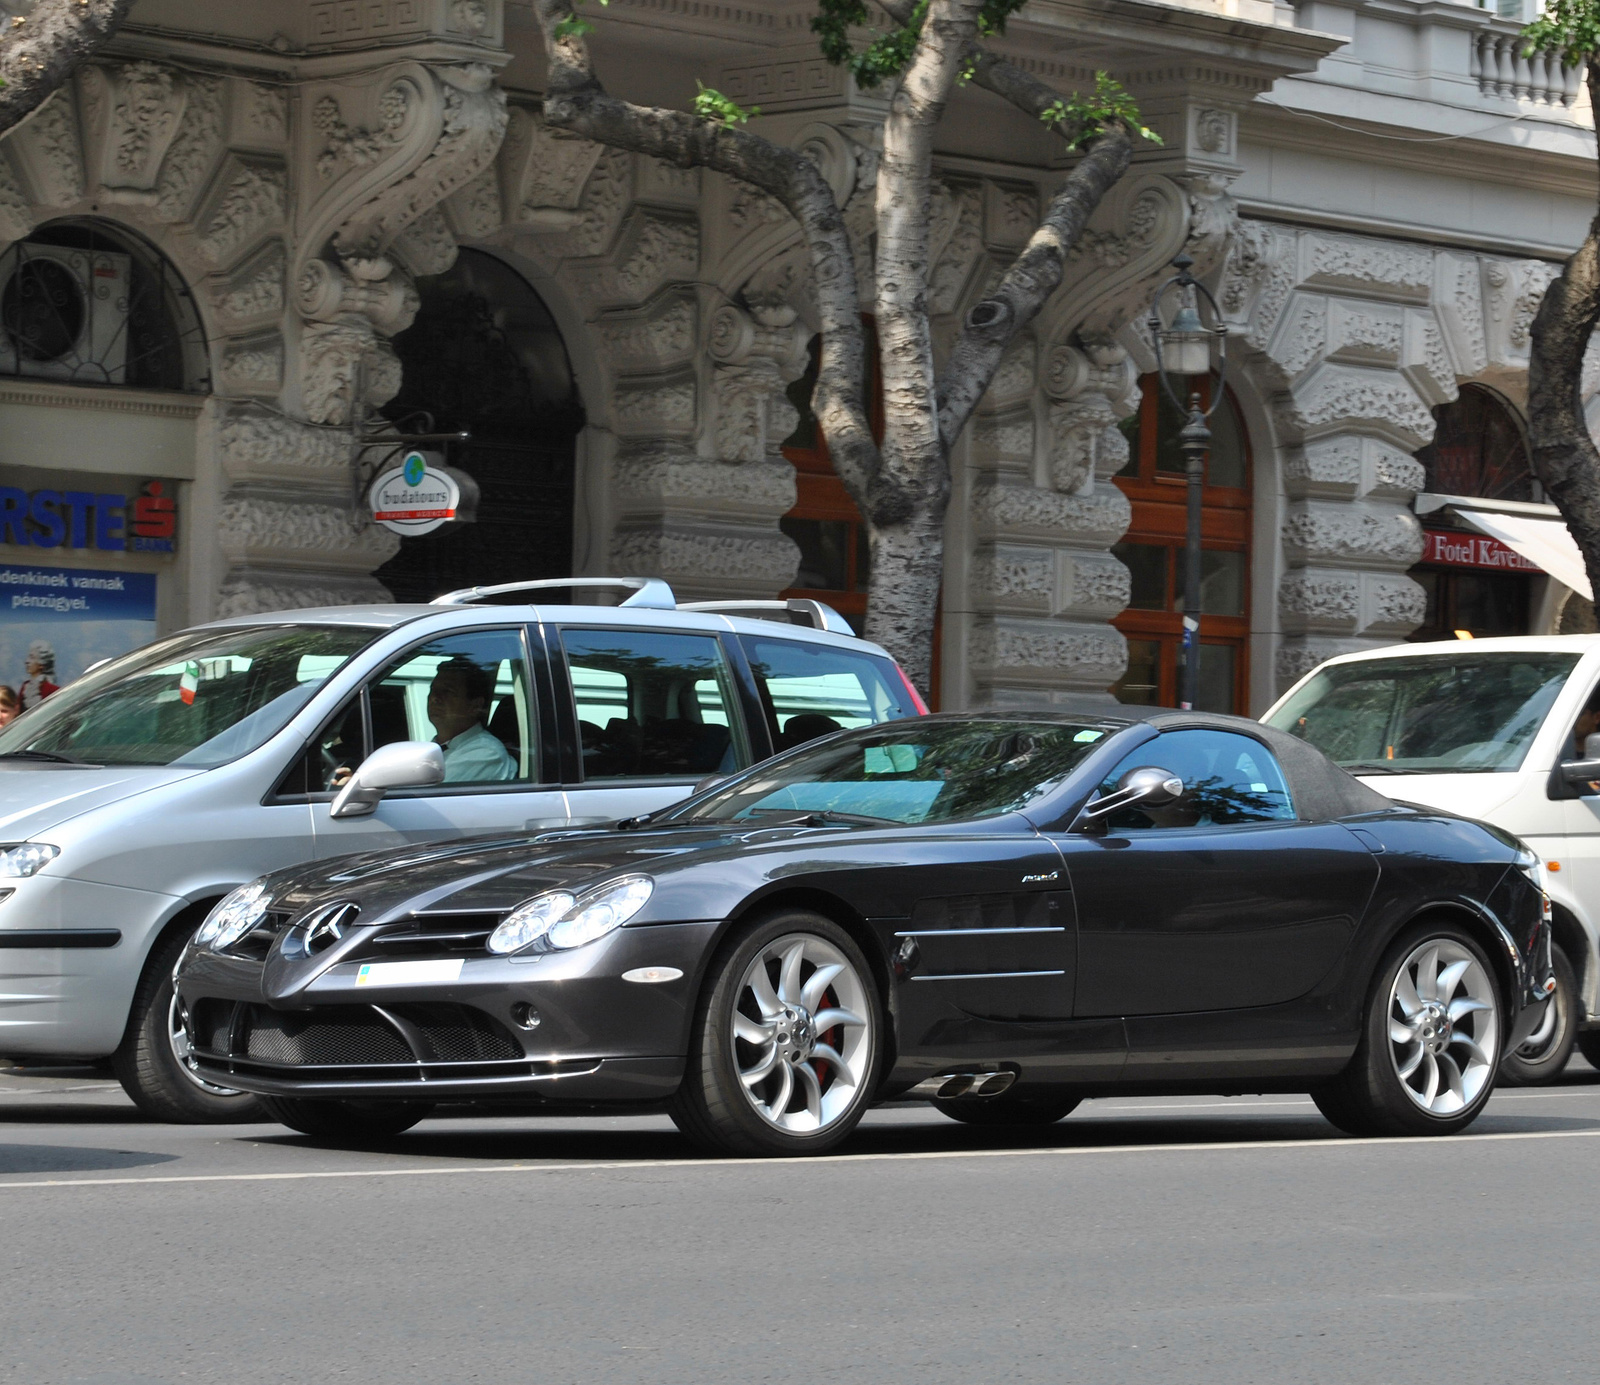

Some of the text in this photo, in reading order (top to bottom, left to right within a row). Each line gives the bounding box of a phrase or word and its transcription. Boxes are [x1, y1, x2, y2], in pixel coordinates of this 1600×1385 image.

[383, 490, 447, 504] budatours
[0, 486, 126, 549] RSTE
[1434, 535, 1475, 564] Fotel
[0, 570, 124, 591] denkinek vannak
[12, 591, 90, 612] pénzügyei.
